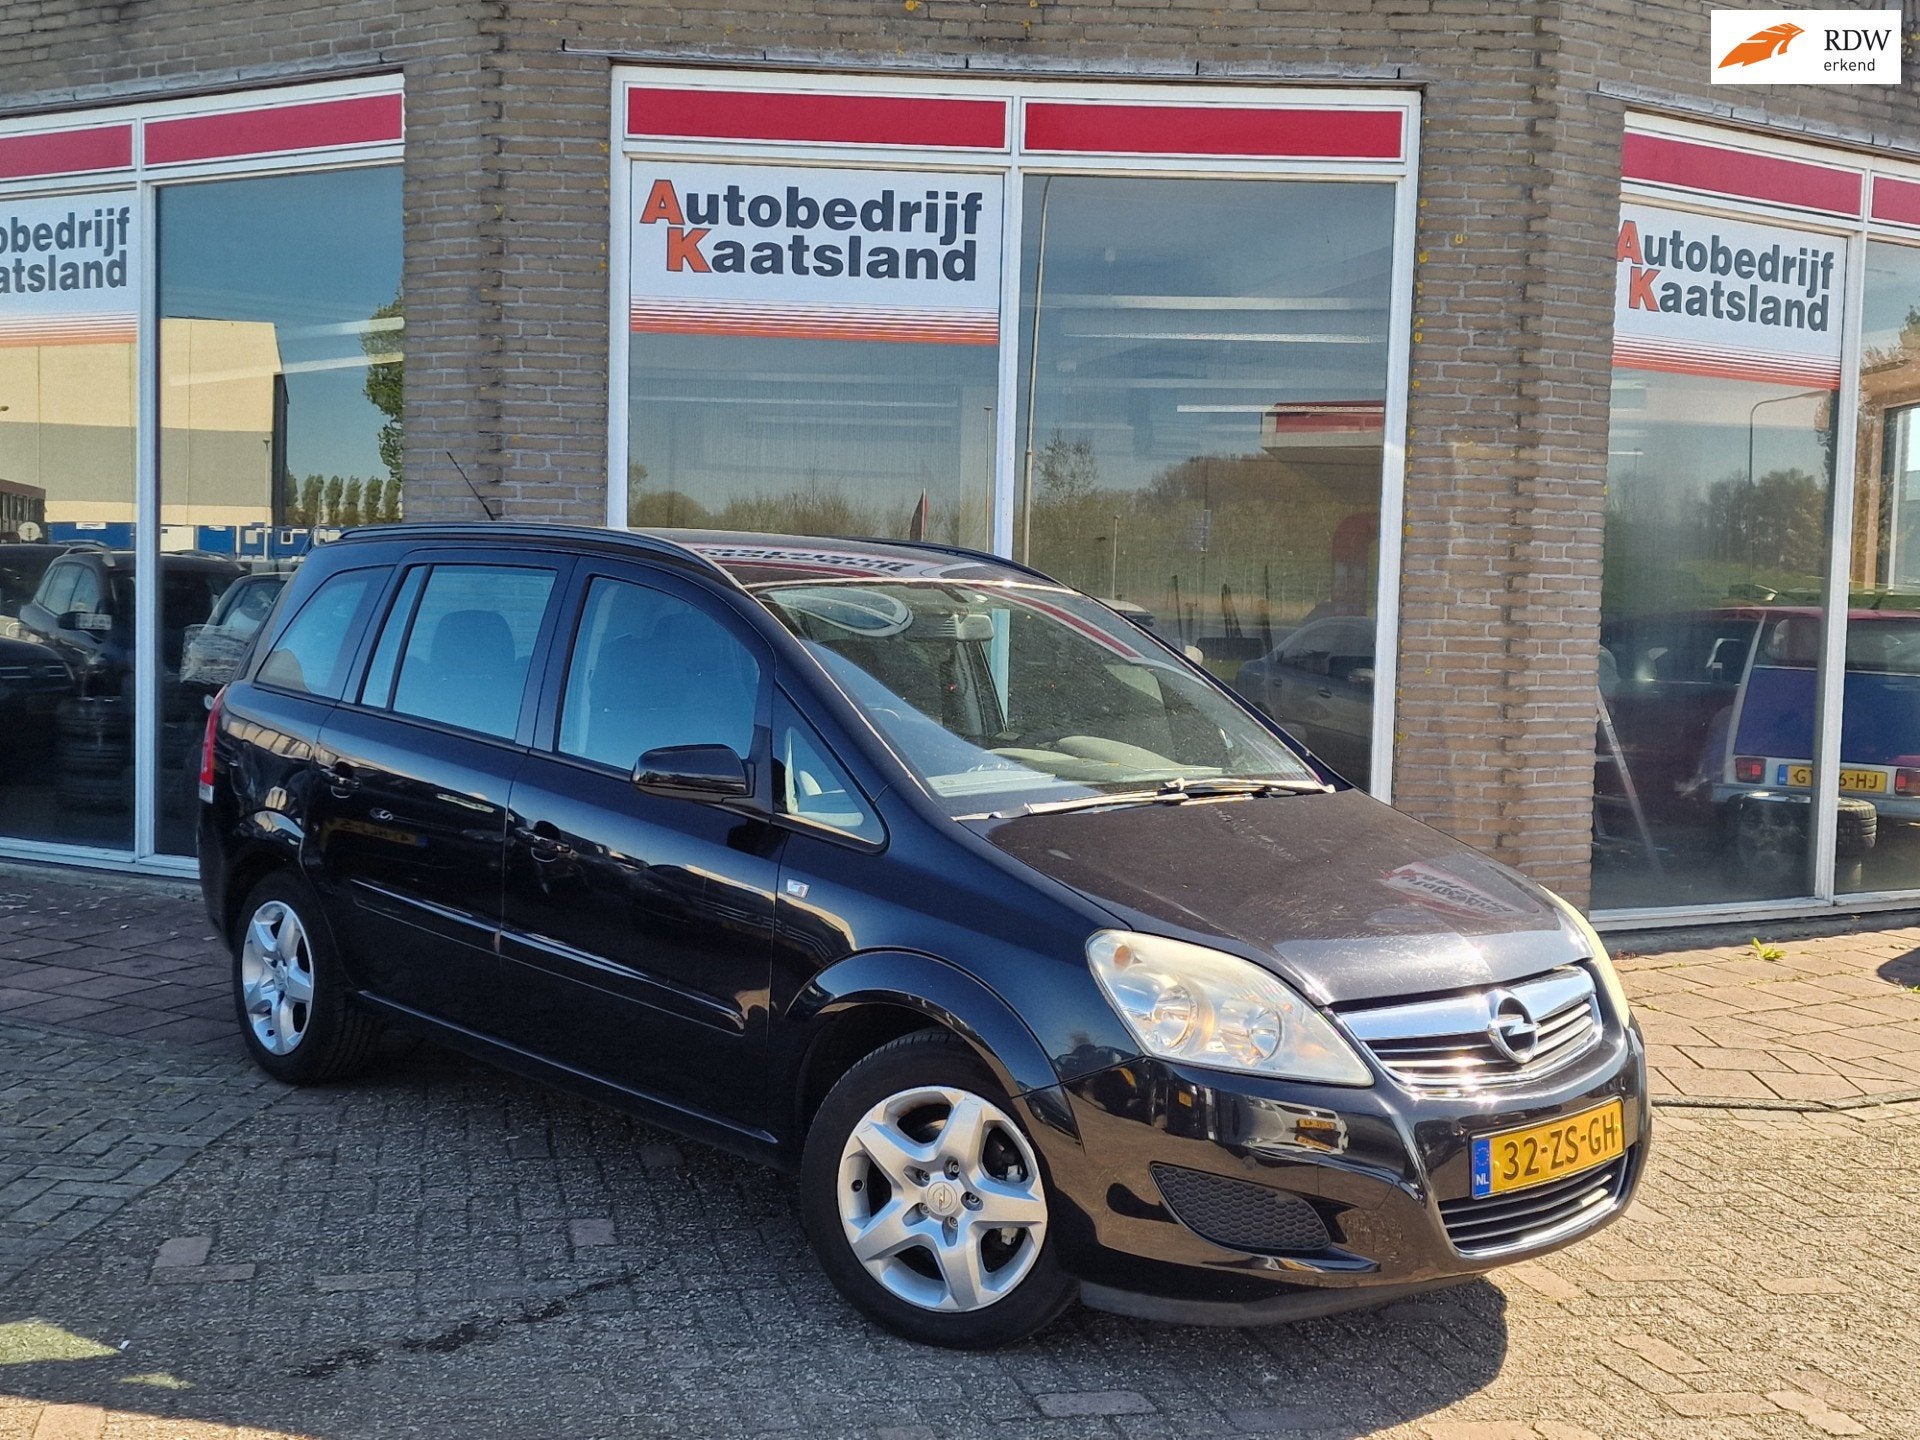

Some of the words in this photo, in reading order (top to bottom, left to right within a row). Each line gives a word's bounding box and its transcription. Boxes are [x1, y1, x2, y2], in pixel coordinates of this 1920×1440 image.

[640, 179, 983, 246] Autobedrijf
[666, 227, 976, 282] Kaatsland
[1616, 220, 1834, 298] Autobedrijf
[1628, 266, 1829, 332] Kaatsland
[1476, 1172, 1490, 1186] NL
[1503, 1112, 1616, 1180] 32-ZS-GH
